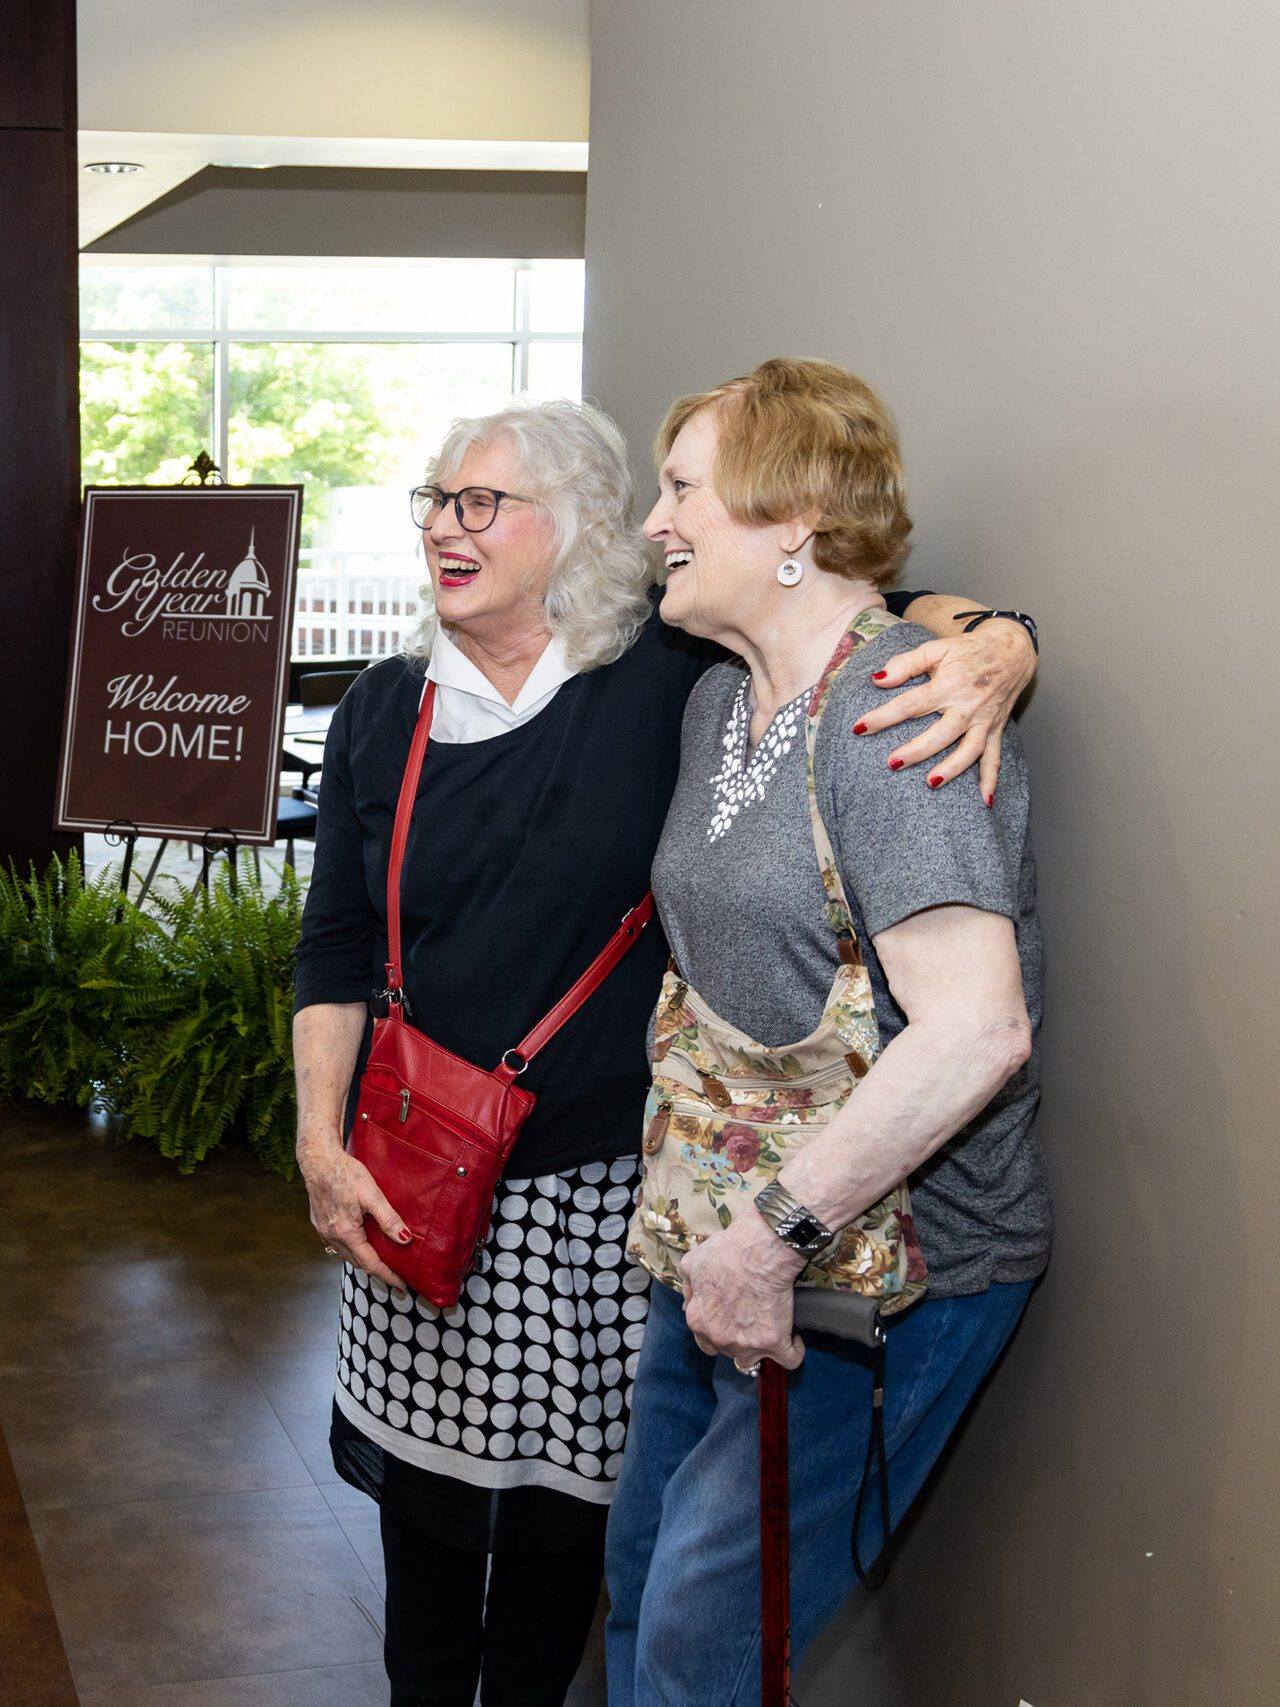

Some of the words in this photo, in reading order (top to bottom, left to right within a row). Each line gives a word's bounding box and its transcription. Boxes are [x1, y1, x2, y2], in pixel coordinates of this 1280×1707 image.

[92, 545, 227, 612] Golden
[121, 578, 224, 637] Year
[162, 620, 269, 643] REUNION
[106, 673, 251, 715] Welcome
[104, 719, 243, 762] HOME!
